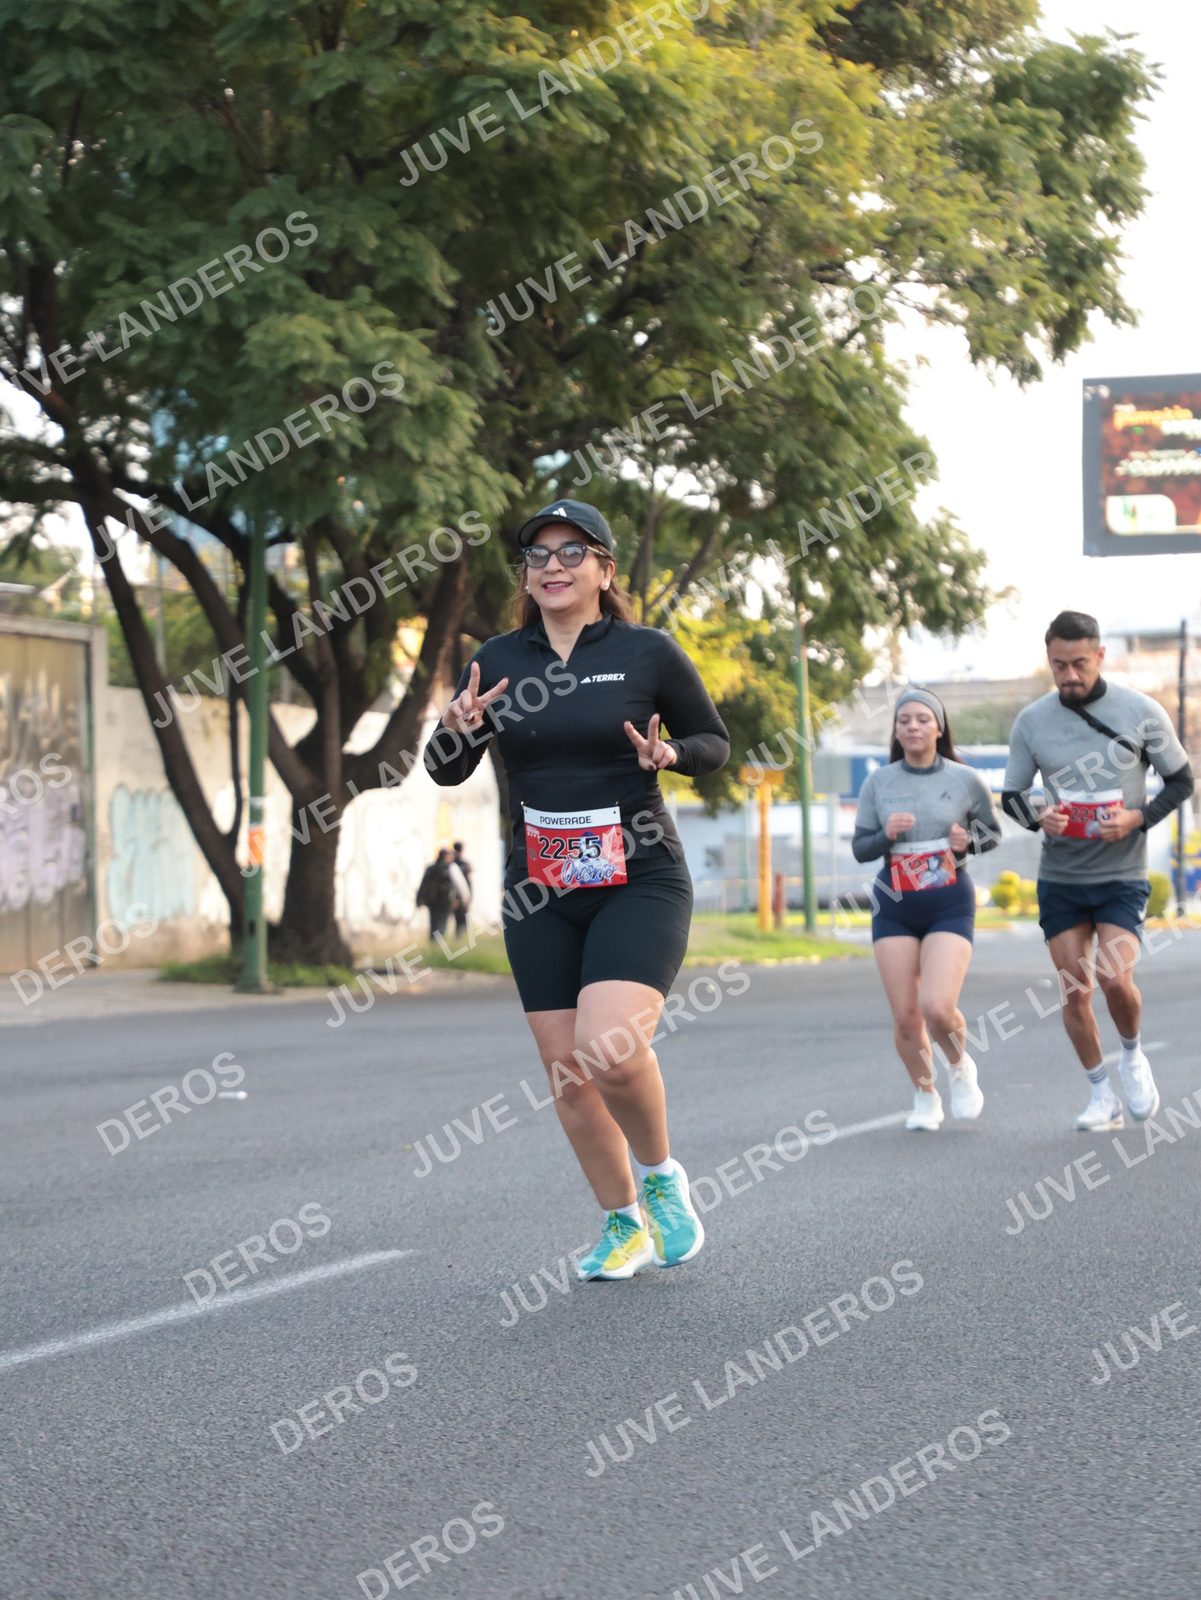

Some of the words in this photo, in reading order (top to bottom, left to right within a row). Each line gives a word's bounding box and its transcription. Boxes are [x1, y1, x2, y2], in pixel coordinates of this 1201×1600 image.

[592, 673, 625, 682] TERREX
[540, 815, 591, 826] POWERADE
[539, 837, 601, 860] 2255
